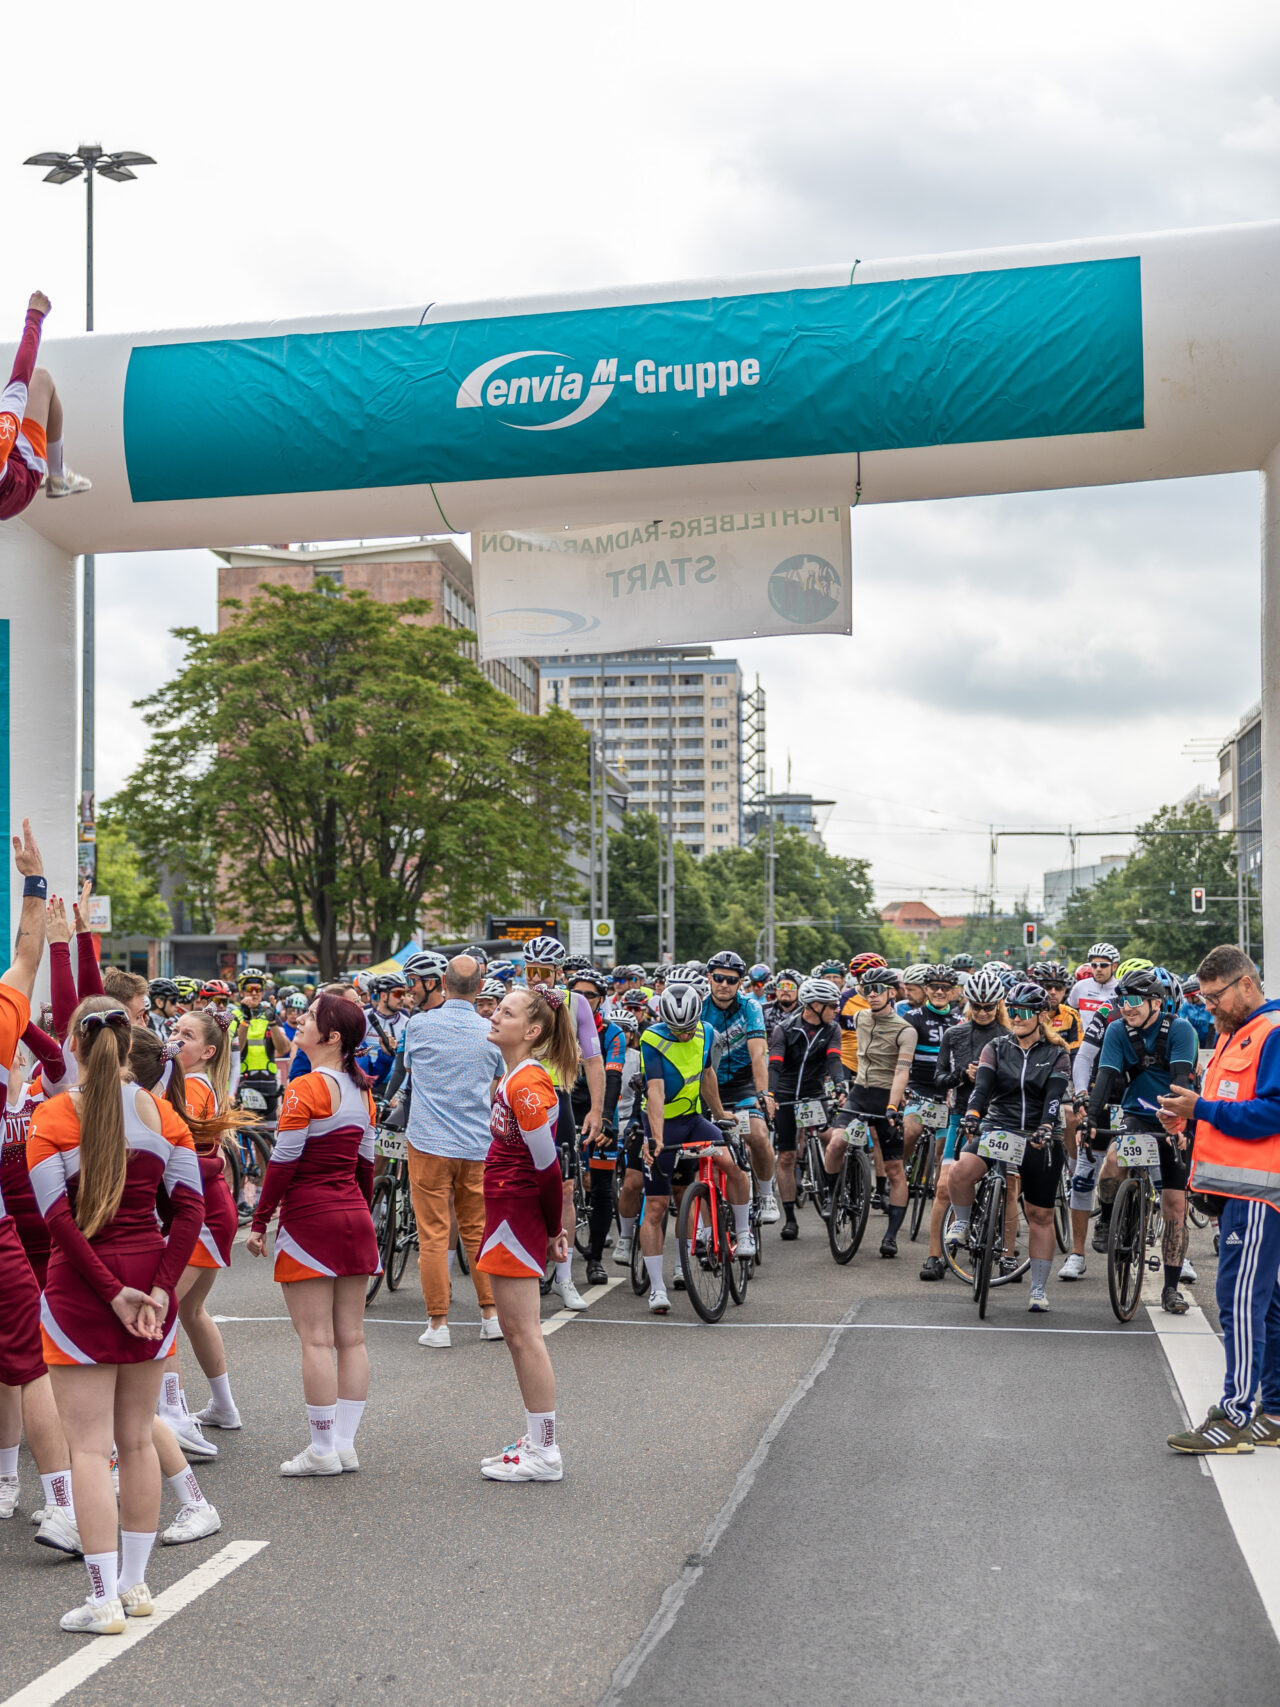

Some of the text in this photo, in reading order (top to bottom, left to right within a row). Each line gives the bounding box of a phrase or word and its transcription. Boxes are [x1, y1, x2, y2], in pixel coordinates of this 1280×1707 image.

[800, 1111, 813, 1120] 257
[922, 1109, 937, 1120] 264
[850, 1128, 865, 1139] 197
[379, 1139, 401, 1150] 1047
[988, 1138, 1009, 1151] 540
[1123, 1146, 1142, 1156] 539
